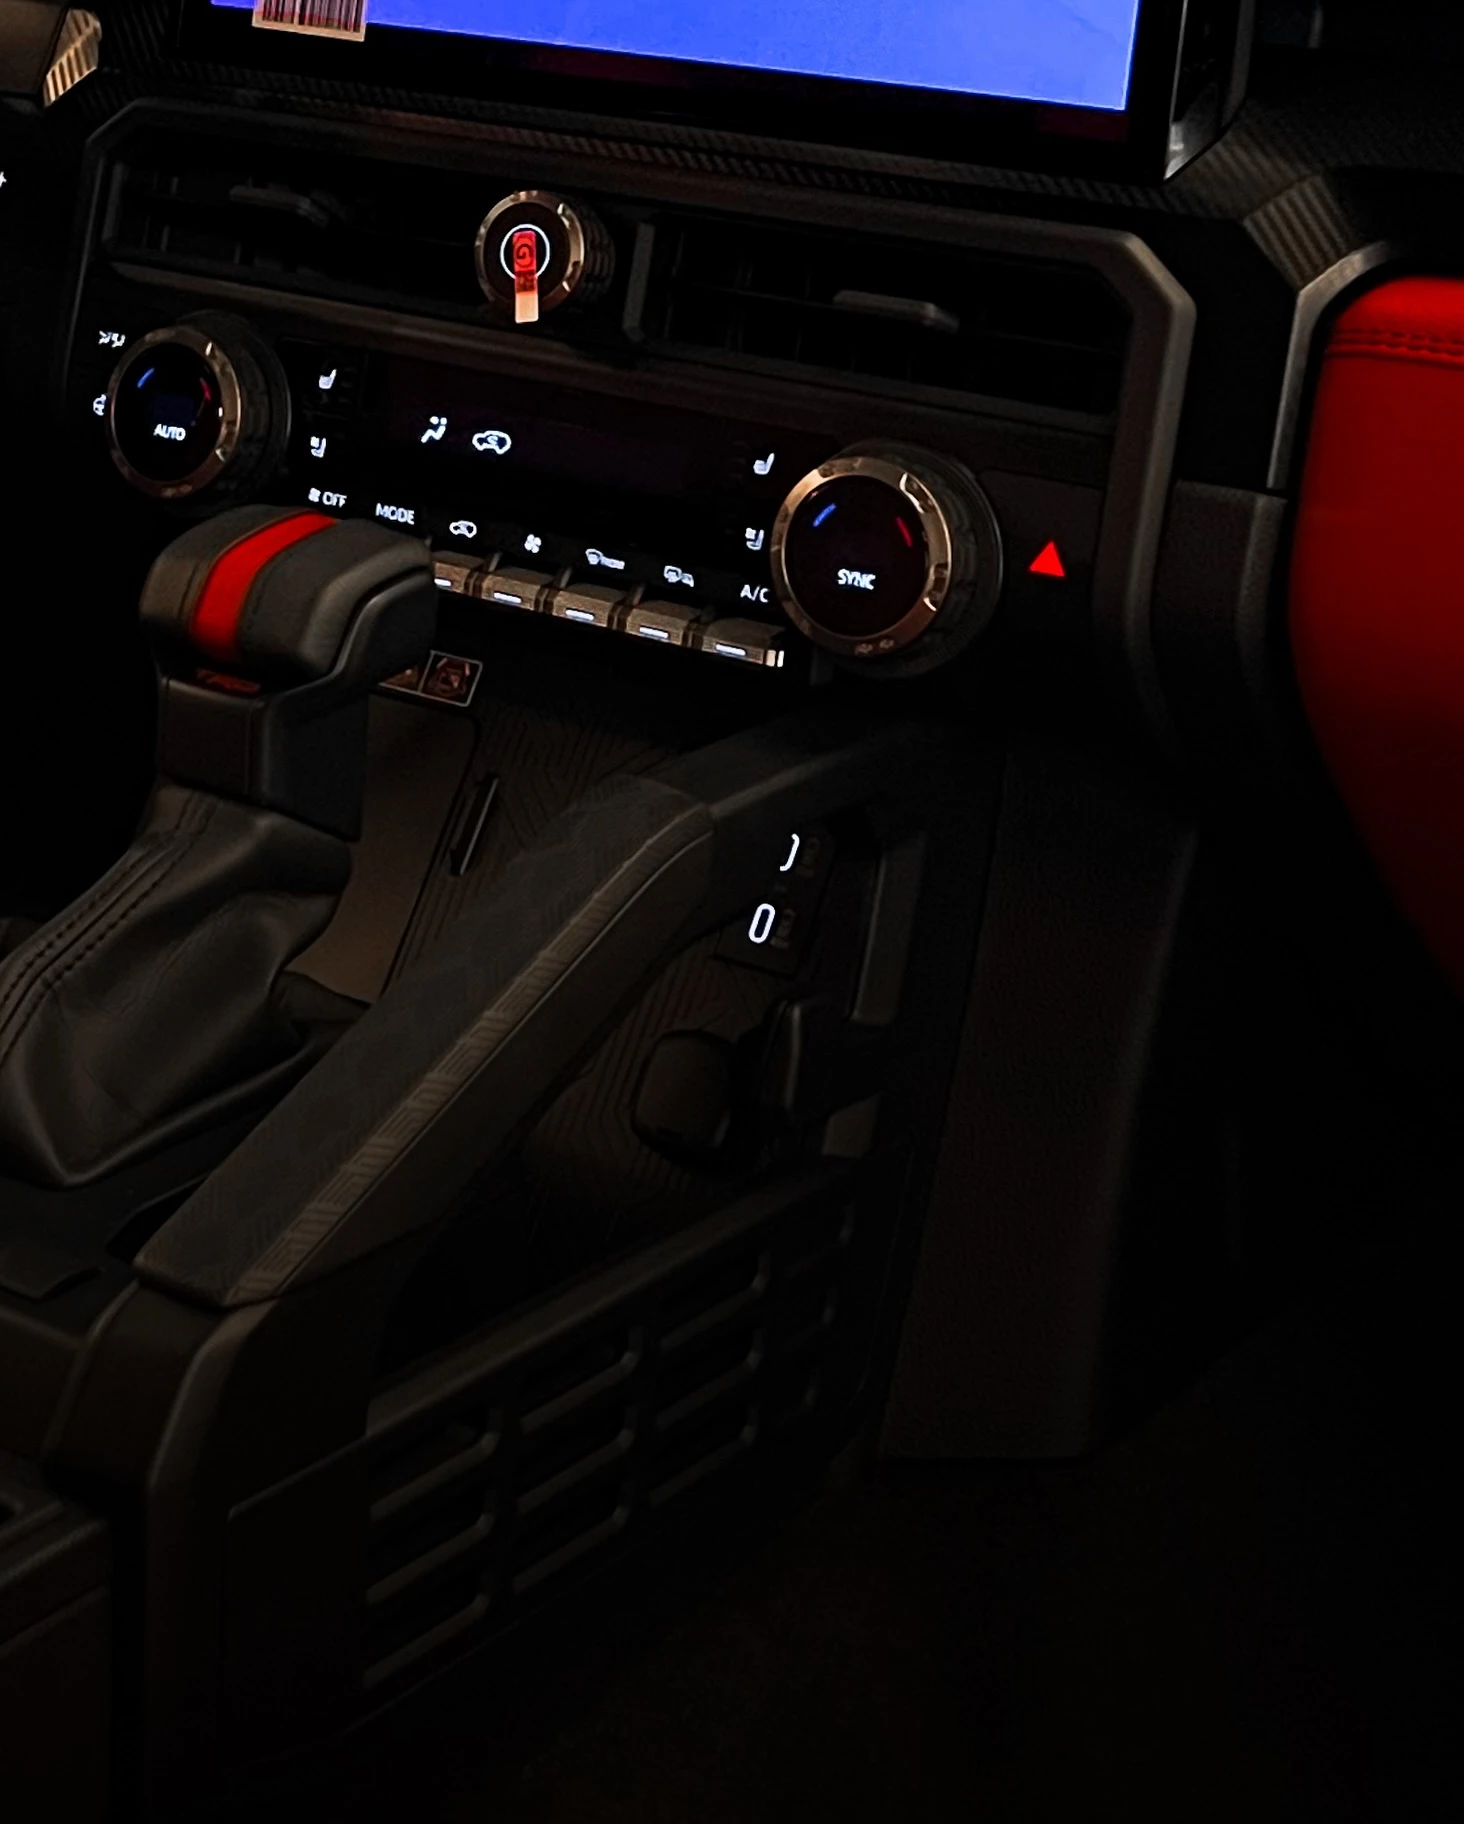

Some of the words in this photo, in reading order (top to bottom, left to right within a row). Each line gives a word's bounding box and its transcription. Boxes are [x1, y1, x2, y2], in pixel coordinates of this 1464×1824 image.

[153, 423, 186, 441] AUTO
[322, 491, 347, 508] OFF
[375, 502, 415, 526] MODE
[837, 568, 876, 590] SYNC
[740, 584, 770, 603] A/C
